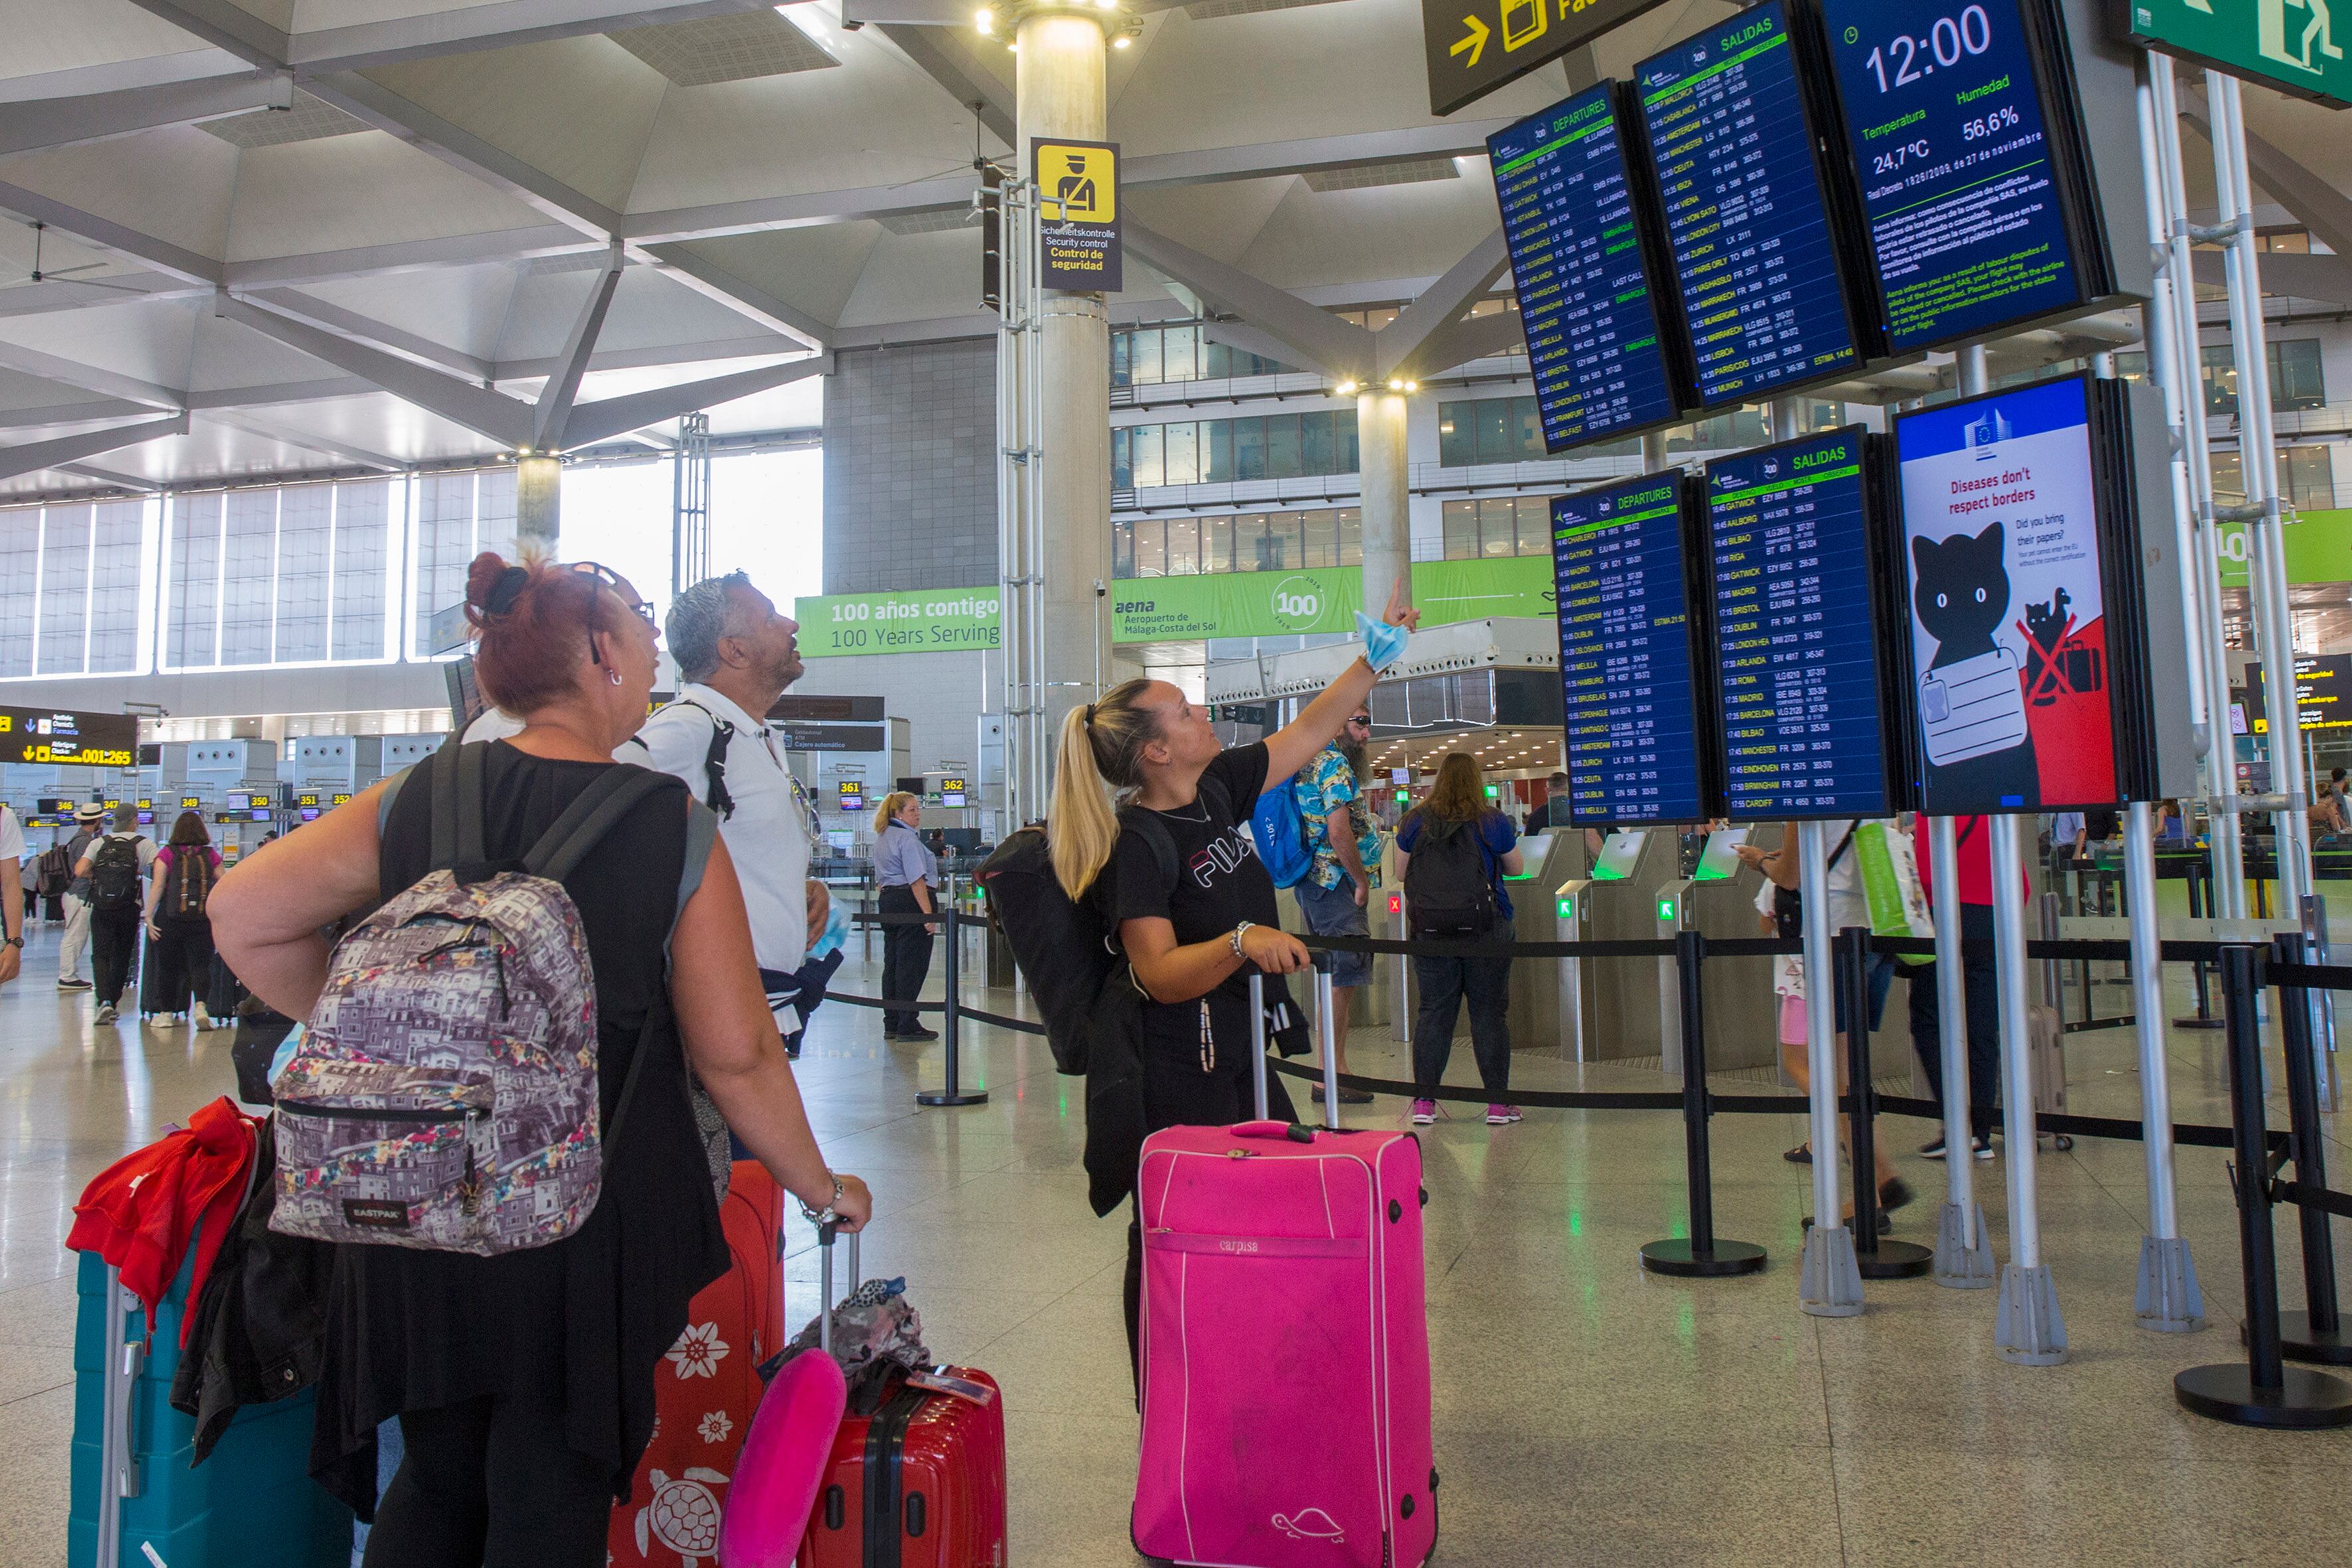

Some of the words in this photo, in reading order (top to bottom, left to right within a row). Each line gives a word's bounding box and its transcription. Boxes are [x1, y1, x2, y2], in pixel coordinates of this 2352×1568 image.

[1559, 0, 1597, 21] Fa
[1719, 15, 1773, 52] SALIDAS
[1865, 4, 1991, 94] 12:00
[1956, 74, 2010, 106] Humedad
[1552, 98, 1607, 133] DEPARTURES
[1663, 104, 1697, 124] CASABLANCA
[1861, 108, 1926, 141] Temperatura
[1962, 106, 2019, 141] 56,6%
[1666, 120, 1701, 141] AMSTERDAM
[1600, 140, 1616, 153] FINAL
[1670, 137, 1703, 157] MANCHESTER
[1673, 159, 1694, 173] CEUTA
[1866, 188, 1881, 201] Real
[1953, 157, 1965, 170] de
[1965, 153, 1978, 165] 27
[1978, 148, 1990, 161] de
[1991, 129, 2042, 156] noviembre
[1676, 179, 1692, 191] IBIZA
[1680, 195, 1699, 208] VIENA
[1683, 212, 1699, 224] LYON
[1699, 205, 1717, 217] SATO
[1874, 226, 1904, 242] laborales
[1904, 223, 1913, 232] de
[1913, 220, 1924, 229] los
[1924, 212, 1947, 226] pilotos
[1947, 208, 1957, 217] de
[1957, 206, 1964, 214] la
[2017, 185, 2027, 194] su
[2027, 177, 2049, 191] vuelo
[1687, 226, 1709, 241] LONDON
[1709, 222, 1721, 232] CITY
[1046, 236, 1078, 248] Security
[1051, 247, 1088, 258] Control
[1091, 250, 1103, 259] de
[1690, 243, 1714, 258] ZURICH
[1052, 260, 1103, 271] seguridad
[1693, 262, 1711, 275] PARIS
[1711, 256, 1728, 268] ORLY
[1612, 275, 1627, 287] LAST
[1627, 270, 1643, 281] CALL
[1700, 290, 1736, 308] MARRAKECH
[1547, 364, 1569, 376] BRISTOL
[1625, 335, 1656, 352] EMBARQUE
[1711, 347, 1735, 360] LISBOA
[1717, 378, 1743, 392] MUNICH
[1555, 408, 1585, 422] FRANKFURT
[1559, 425, 1583, 437] BELFAST
[1792, 445, 1845, 470] SALIDAS
[1950, 473, 1998, 494] Diseases
[2001, 466, 2031, 484] don't
[1618, 486, 1672, 509] DEPARTURES
[1726, 497, 1755, 510] GATWICK
[1948, 495, 1989, 517] respect
[1992, 485, 2035, 507] borders
[1727, 514, 1757, 527] AALBORG
[2016, 518, 2028, 528] Did
[2030, 518, 2043, 528] you
[2045, 511, 2064, 526] bring
[1728, 534, 1751, 545] BILBAO
[2017, 534, 2034, 546] their
[2036, 529, 2065, 545] papers?
[1569, 548, 1593, 559] GATWICK
[1729, 552, 1745, 562] RIGA
[1570, 566, 1590, 575] MADRID
[1731, 567, 1760, 580] GATWICK
[1306, 576, 1320, 589] 2019
[1571, 580, 1599, 590] BARCELONA
[1732, 586, 1756, 597] MADRID
[832, 603, 869, 622] 100
[874, 600, 919, 620] años
[925, 596, 999, 619] contigo
[1115, 600, 1155, 614] aena
[1277, 591, 1317, 617] 100
[1733, 603, 1759, 615] BRISTOL
[1125, 613, 1176, 624] Aeropuerto
[1275, 615, 1291, 629] 1919
[1125, 623, 1184, 634] Málaga-Costa
[1186, 623, 1200, 631] del
[1202, 622, 1216, 631] Sol
[1734, 621, 1757, 631] DUBLIN
[832, 629, 867, 647] 100
[875, 628, 923, 645] Years
[931, 623, 1000, 644] Serving
[1735, 639, 1757, 649] LONDON
[1576, 661, 1597, 669] MELILLA
[1736, 656, 1766, 666] ARLANDA
[1577, 676, 1603, 686] HAMBURG
[1737, 675, 1756, 684] ROMA
[2305, 670, 2334, 679] seguridad
[1578, 693, 1606, 702] BRUSELAS
[1739, 692, 1763, 702] MADRID
[1739, 708, 1774, 720] BARCELONA
[1741, 728, 1764, 738] BILBAO
[1581, 742, 1610, 750] AMSTERDAM
[1742, 745, 1776, 755] MANCHESTER
[82, 749, 105, 764] 001
[109, 750, 131, 765] 265
[1743, 763, 1778, 773] EINDHOVEN
[840, 783, 859, 793] 361
[943, 780, 963, 790] 362
[1744, 781, 1779, 791] BIRMINGHAM
[57, 801, 73, 811] 346
[104, 800, 118, 809] 347
[182, 798, 198, 807] 349
[252, 797, 268, 806] 350
[300, 795, 317, 805] 351
[1745, 799, 1773, 808] CARDIFF
[1190, 825, 1251, 888] FILA
[354, 1209, 398, 1219] EASTPAK
[1219, 1240, 1258, 1255] carpisa
